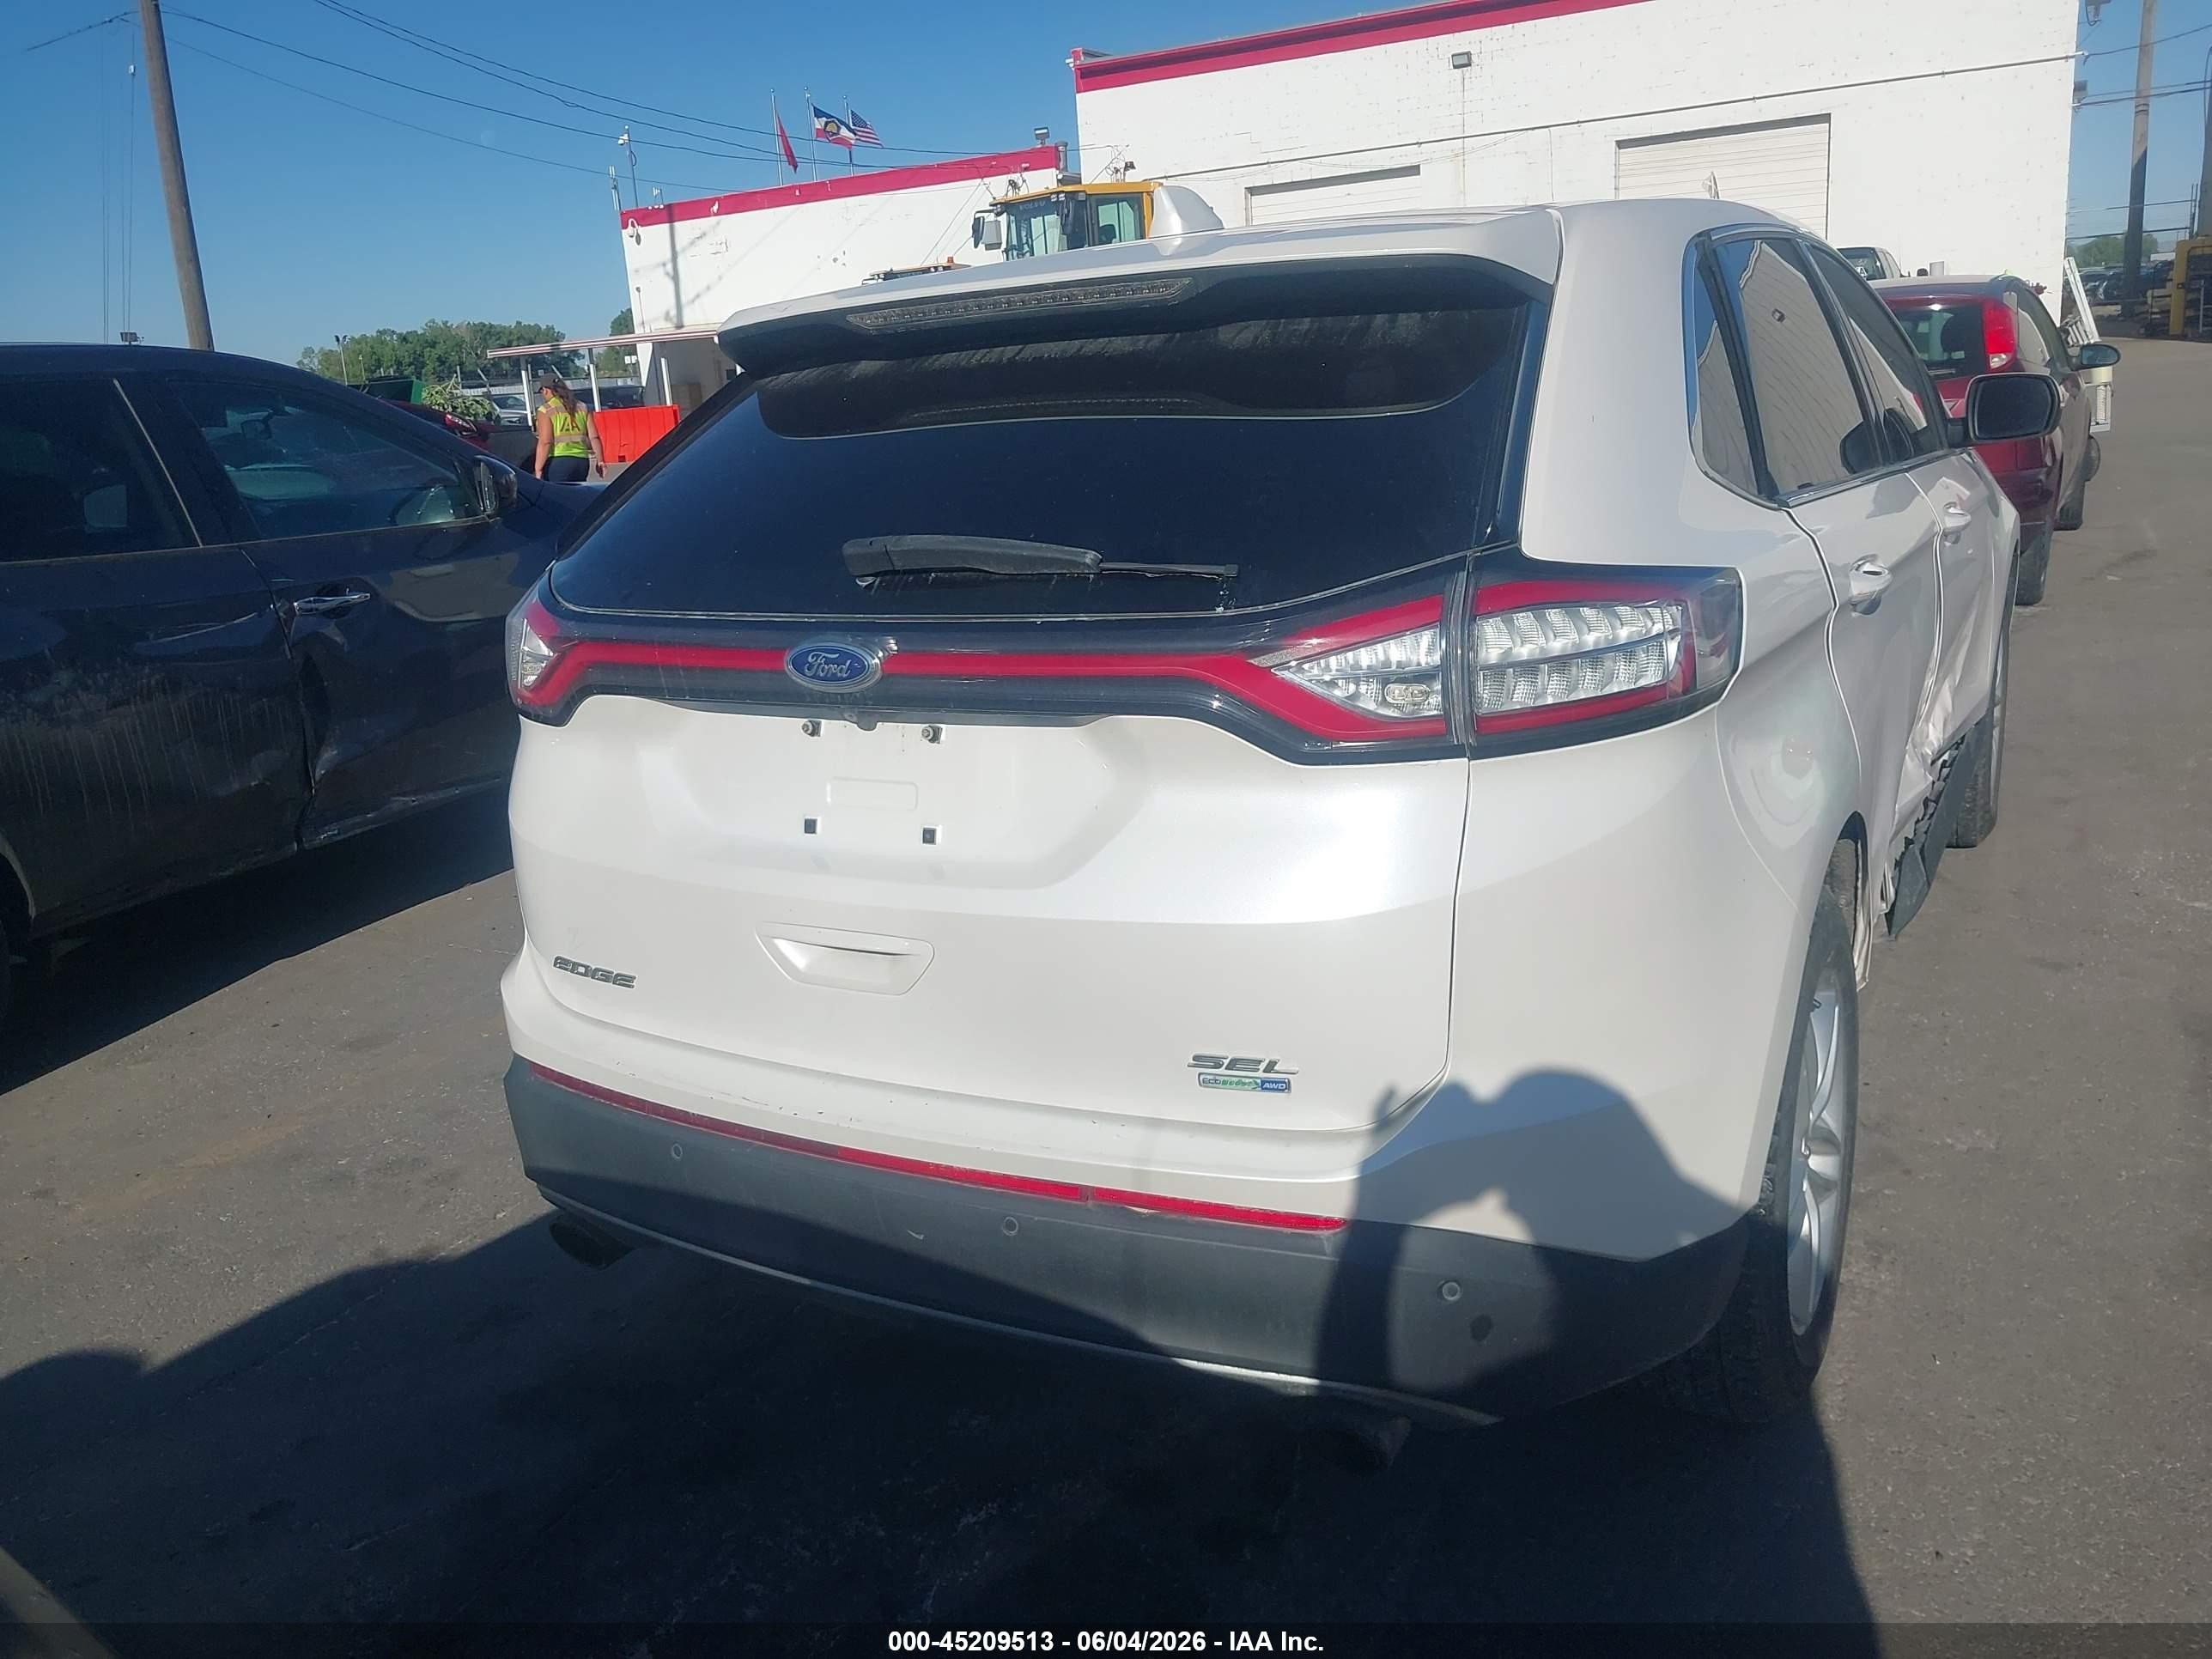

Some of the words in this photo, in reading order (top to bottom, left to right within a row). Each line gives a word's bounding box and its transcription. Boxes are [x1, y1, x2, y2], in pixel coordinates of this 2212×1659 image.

[805, 651, 852, 678] Ford
[553, 955, 637, 989] EDGE
[1187, 1053, 1299, 1075] SEL
